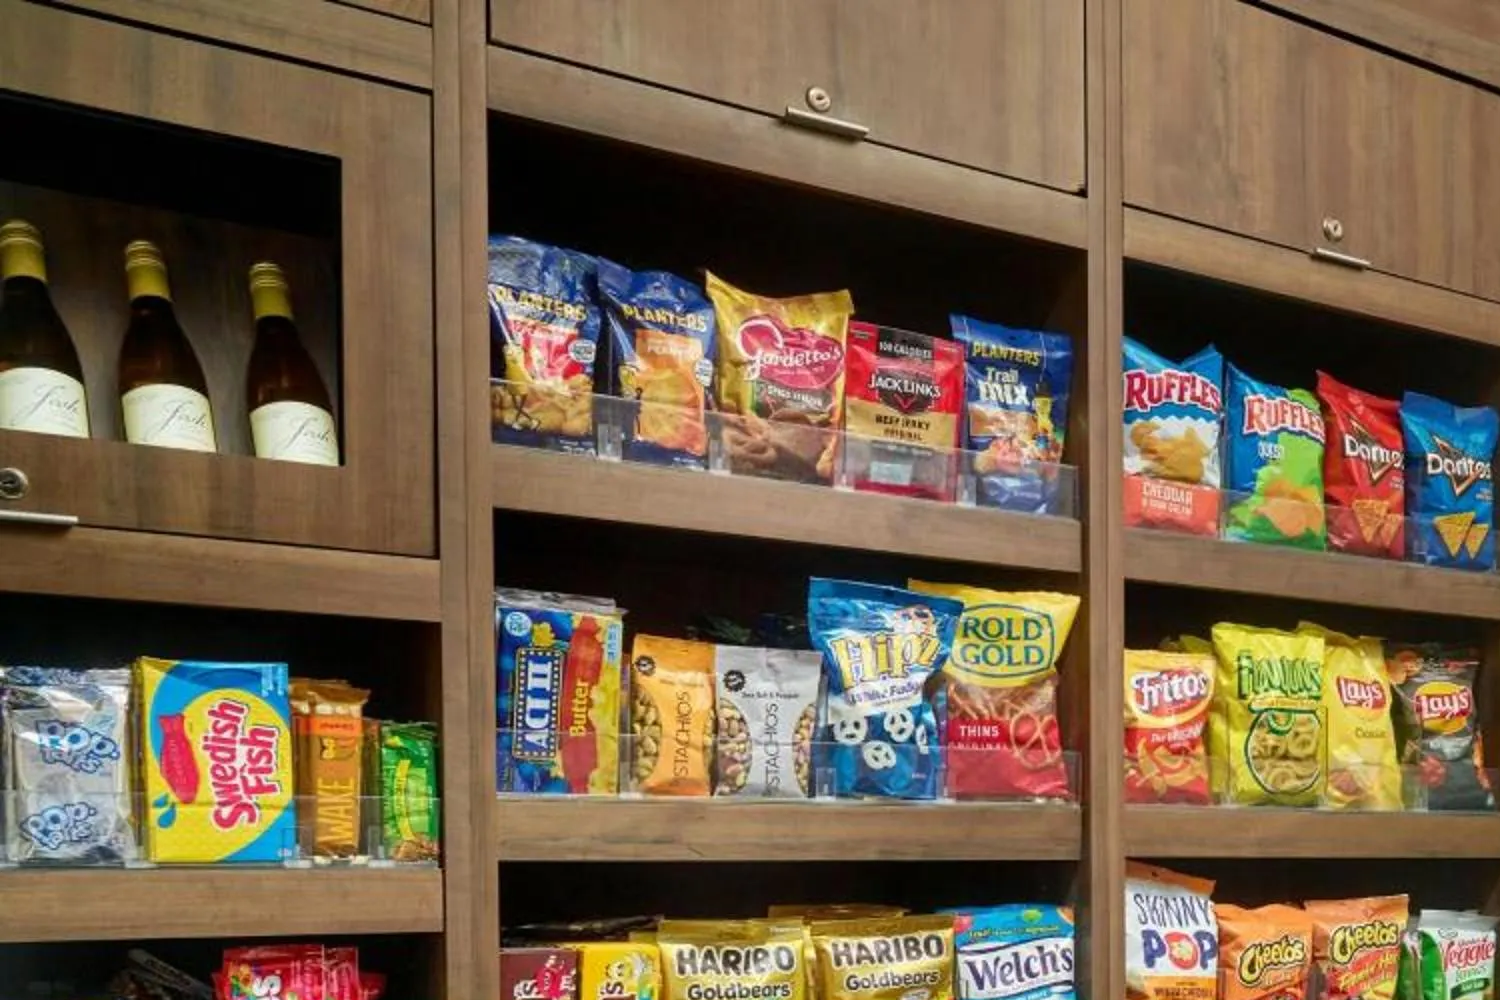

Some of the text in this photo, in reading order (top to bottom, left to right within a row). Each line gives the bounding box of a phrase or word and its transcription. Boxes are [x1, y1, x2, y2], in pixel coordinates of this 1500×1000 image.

[494, 284, 590, 322] PLANTERS
[621, 302, 708, 333] PLANTERS
[972, 341, 1042, 366] PLANTERS
[869, 373, 902, 394] JACK
[1124, 370, 1222, 414] RUFFLES
[1244, 395, 1325, 437] RUFFLES
[1426, 452, 1492, 480] Doritos
[961, 616, 1043, 641] ROLD
[959, 643, 1045, 667] GOLD
[569, 681, 590, 737] Butter
[1131, 669, 1210, 712] Fritos
[1339, 678, 1383, 708] Lay's
[1419, 688, 1470, 719] Lay's
[525, 691, 550, 750] ACT
[959, 724, 1000, 737] THINS
[203, 700, 278, 829] Swedish Fish
[316, 776, 355, 846] WAKE
[1133, 892, 1211, 929] SKINNY
[676, 945, 796, 976] HARIBO
[832, 934, 945, 967] HARIBO
[1141, 929, 1218, 970] POP
[1240, 936, 1305, 986] Cheetos
[1332, 921, 1399, 964] Cheetos
[846, 970, 939, 991] Goldbears
[965, 943, 1074, 991] Welch's
